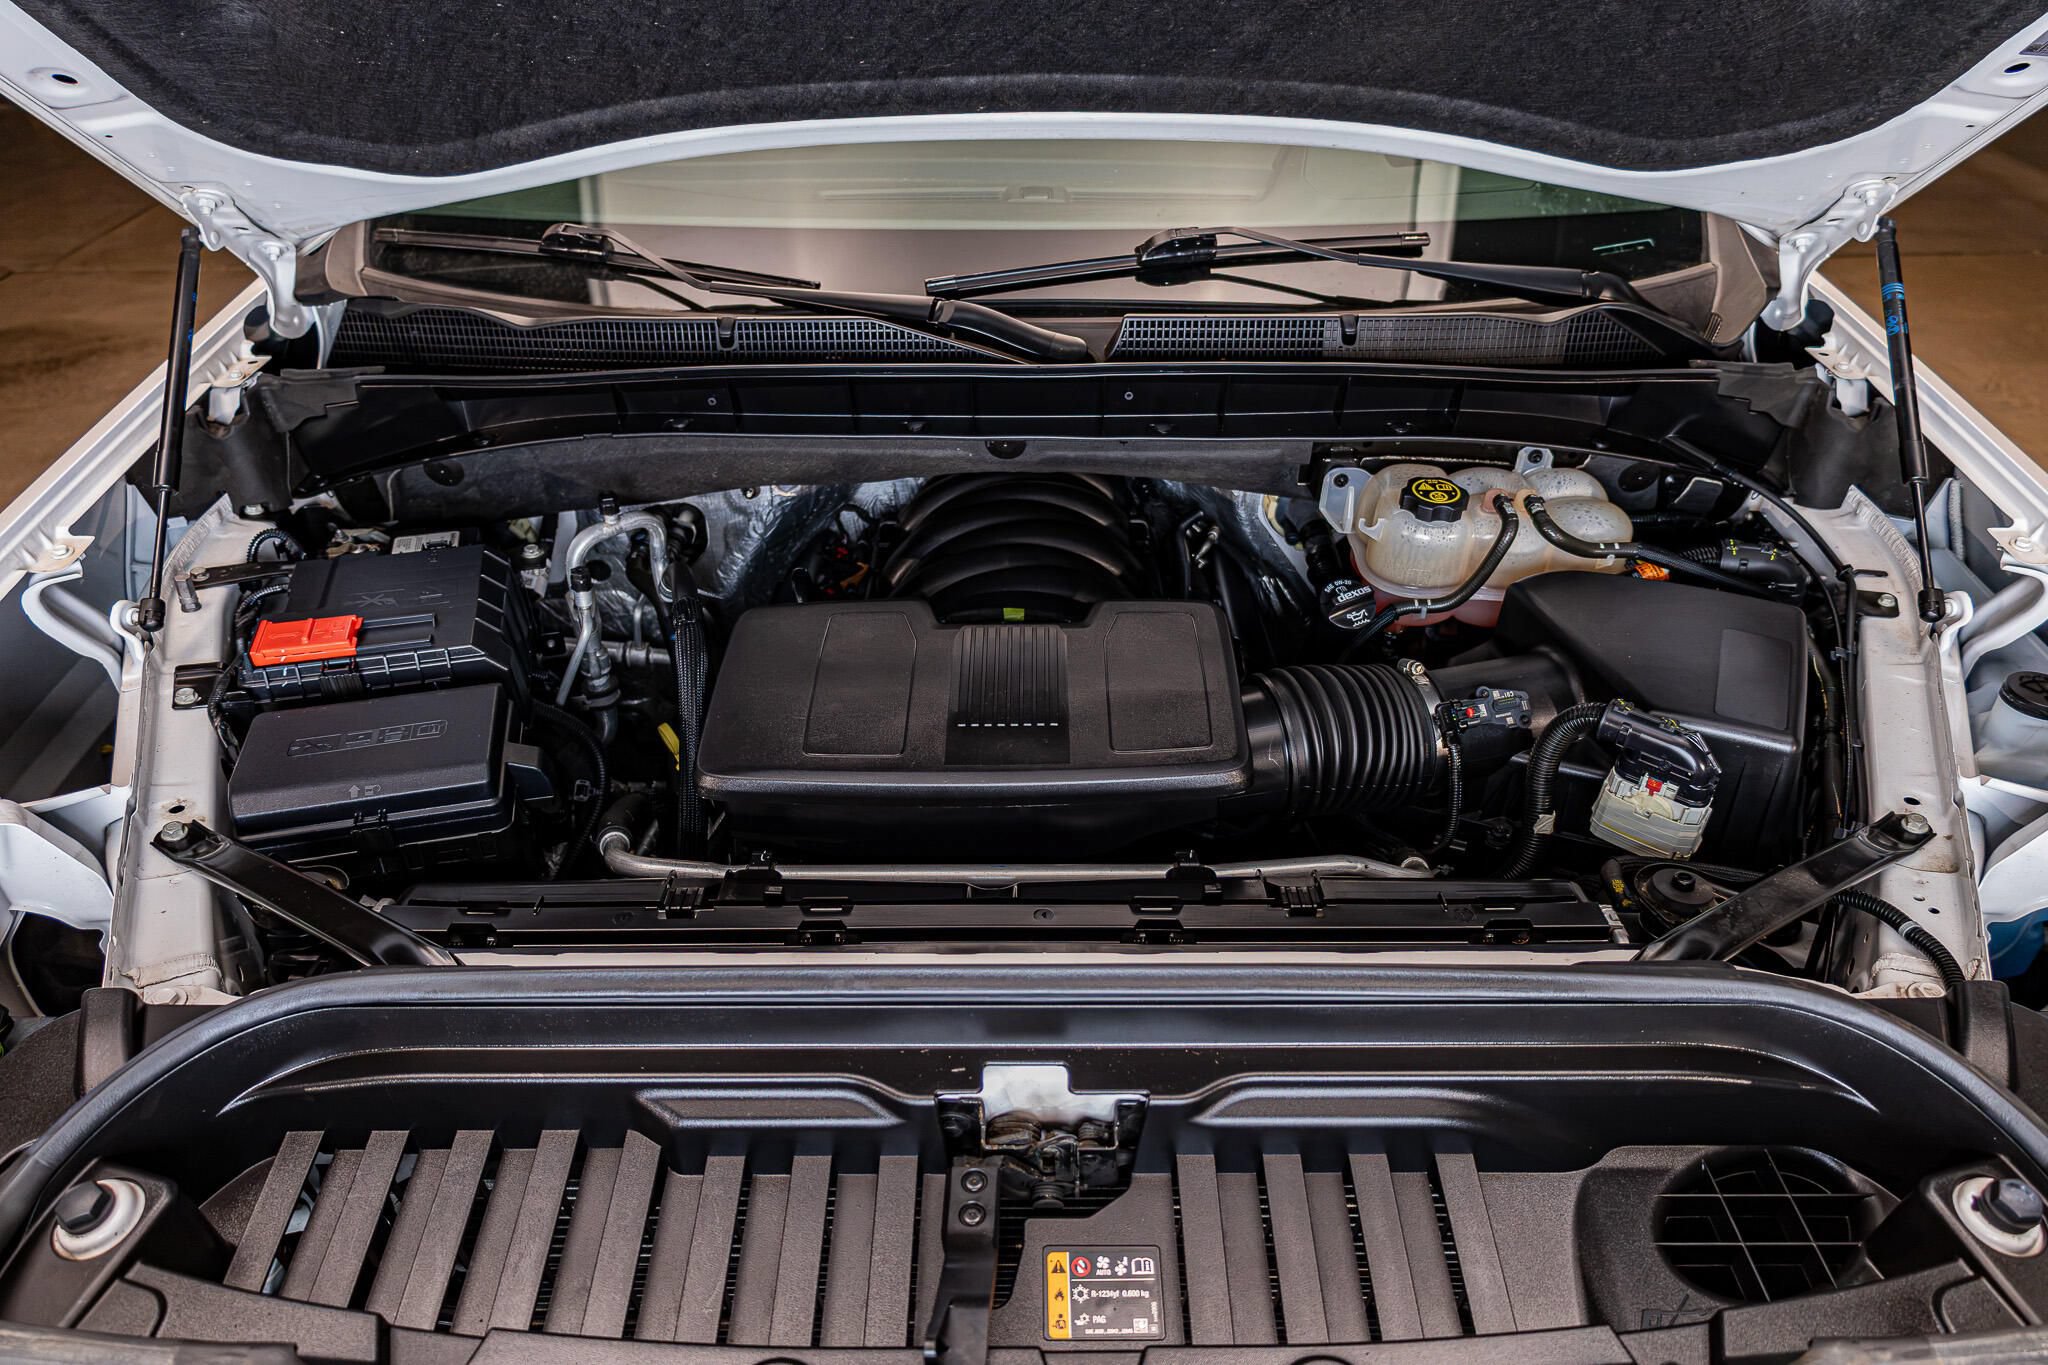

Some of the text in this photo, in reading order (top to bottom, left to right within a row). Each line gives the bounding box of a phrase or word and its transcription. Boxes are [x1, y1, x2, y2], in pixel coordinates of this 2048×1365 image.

[1337, 585, 1372, 603] dexos
[1141, 1290, 1150, 1299] kg
[1092, 1315, 1107, 1324] PAG
